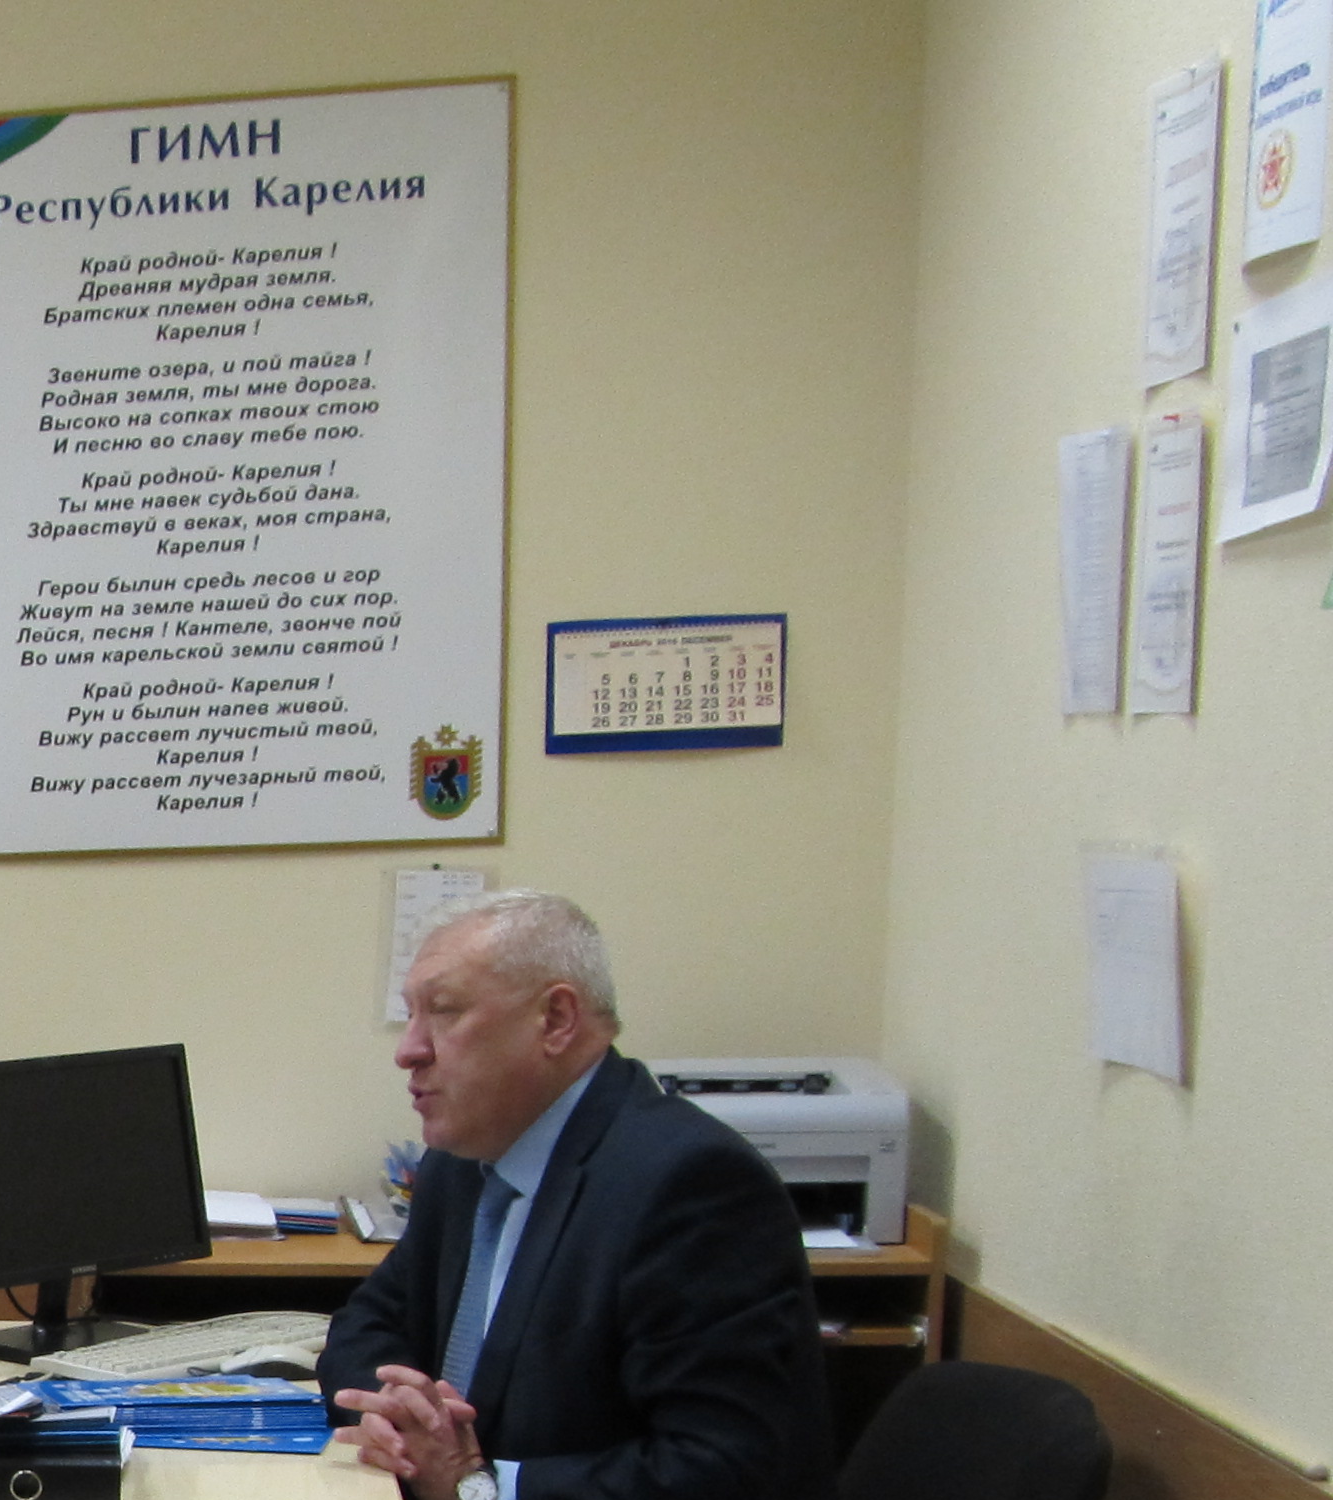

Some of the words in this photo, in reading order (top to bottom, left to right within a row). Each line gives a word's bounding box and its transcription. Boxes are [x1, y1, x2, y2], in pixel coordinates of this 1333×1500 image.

[130, 118, 281, 164] ГИМН
[254, 175, 426, 215] Карелия
[80, 255, 132, 277] Край
[138, 249, 225, 275] родной-
[231, 246, 323, 268] Карелия
[330, 242, 337, 259] !
[78, 277, 172, 302] Древняя
[178, 272, 259, 295] мудрая
[265, 270, 336, 287] земля.
[43, 304, 150, 325] Братских
[156, 300, 237, 318] племен
[243, 293, 295, 312] одна
[302, 292, 375, 308] семья,
[155, 323, 247, 344] Карелия
[253, 318, 261, 335] !
[47, 366, 142, 384] Звените
[148, 362, 215, 381] озера,
[222, 360, 236, 374] и
[242, 355, 282, 373] пой
[288, 351, 357, 370] тайга
[364, 348, 371, 365] !
[41, 389, 119, 408] Родная
[125, 387, 195, 403] земля,
[202, 384, 240, 399] ты
[246, 382, 288, 396] мне
[294, 376, 377, 397] дорога.
[39, 414, 121, 433] Высоко
[127, 413, 153, 428] на
[159, 408, 233, 426] сопках
[239, 403, 310, 420] твоих
[316, 401, 380, 416] стою
[53, 437, 69, 455] И
[74, 437, 143, 454] песню
[149, 436, 175, 450] во
[181, 431, 245, 449] славу
[250, 425, 308, 444] тебе
[313, 425, 365, 441] пою.
[81, 471, 132, 492] Край
[138, 466, 225, 491] родной-
[231, 463, 322, 485] Карелия
[329, 460, 336, 477] !
[57, 496, 88, 514] Ты
[94, 497, 135, 512] мне
[141, 494, 202, 510] навек
[207, 487, 298, 509] судьбой
[304, 483, 360, 501] дана.
[26, 517, 157, 540] Здравствуй
[163, 518, 176, 532] в
[183, 515, 249, 531] веках,
[255, 512, 298, 528] моя
[304, 508, 392, 529] страна,
[156, 538, 246, 559] Карелия
[252, 533, 259, 551] !
[37, 579, 101, 599] Герои
[106, 575, 177, 594] былин
[183, 571, 246, 594] средь
[251, 571, 316, 588] лесов
[323, 570, 337, 584] и
[342, 569, 381, 586] гор
[19, 602, 94, 622] Живут
[100, 604, 125, 617] на
[131, 600, 195, 616] земле
[200, 593, 270, 613] нашей
[276, 592, 303, 610] до
[309, 594, 347, 609] сих
[353, 592, 399, 608] пор.
[16, 624, 86, 643] Лейся,
[92, 625, 155, 640] песня
[162, 621, 168, 638] !
[175, 620, 274, 637] Кантеле,
[280, 617, 356, 633] звонче
[361, 612, 402, 629] пой
[20, 650, 48, 667] Во
[54, 651, 95, 666] имя
[101, 642, 224, 667] карельской
[230, 643, 296, 659] земли
[301, 636, 385, 656] святой
[391, 634, 398, 651] !
[684, 657, 689, 667] 1
[711, 655, 719, 666] 2
[738, 654, 746, 665] 3
[765, 653, 772, 664] 4
[82, 682, 133, 703] Край
[139, 678, 225, 701] родной-
[230, 676, 321, 696] Карелия
[327, 673, 334, 690] !
[593, 690, 610, 699] 12
[620, 689, 637, 699] 13
[647, 687, 664, 698] 14
[675, 685, 691, 696] 15
[702, 684, 719, 695] 16
[728, 683, 745, 693] 17
[757, 682, 773, 692] 18
[602, 674, 610, 685] 5
[629, 674, 638, 684] 6
[656, 672, 664, 682] 7
[683, 671, 691, 681] 8
[711, 669, 719, 680] 9
[729, 669, 746, 680] 10
[757, 668, 772, 678] 11
[67, 705, 105, 724] Рун
[111, 708, 125, 721] и
[131, 702, 201, 720] былин
[207, 702, 270, 718] напев
[276, 696, 350, 715] живой.
[592, 717, 610, 728] 26
[619, 716, 637, 726] 27
[646, 714, 664, 725] 28
[674, 714, 692, 724] 29
[701, 712, 719, 722] 30
[728, 711, 745, 721] 31
[593, 703, 610, 714] 19
[619, 702, 638, 713] 20
[645, 701, 661, 712] 21
[674, 700, 692, 710] 22
[701, 698, 719, 709] 23
[728, 697, 745, 707] 24
[755, 696, 774, 706] 25
[38, 729, 94, 747] Вижу
[99, 728, 190, 749] рассвет
[196, 720, 309, 744] лучистый
[315, 718, 379, 737] твой,
[156, 749, 245, 768] Карелия
[251, 745, 258, 761] !
[30, 775, 87, 795] Вижу
[91, 774, 182, 795] рассвет
[188, 766, 317, 790] лучезарный
[323, 764, 387, 783] твой,
[156, 795, 245, 814] Карелия
[251, 791, 258, 808] !
